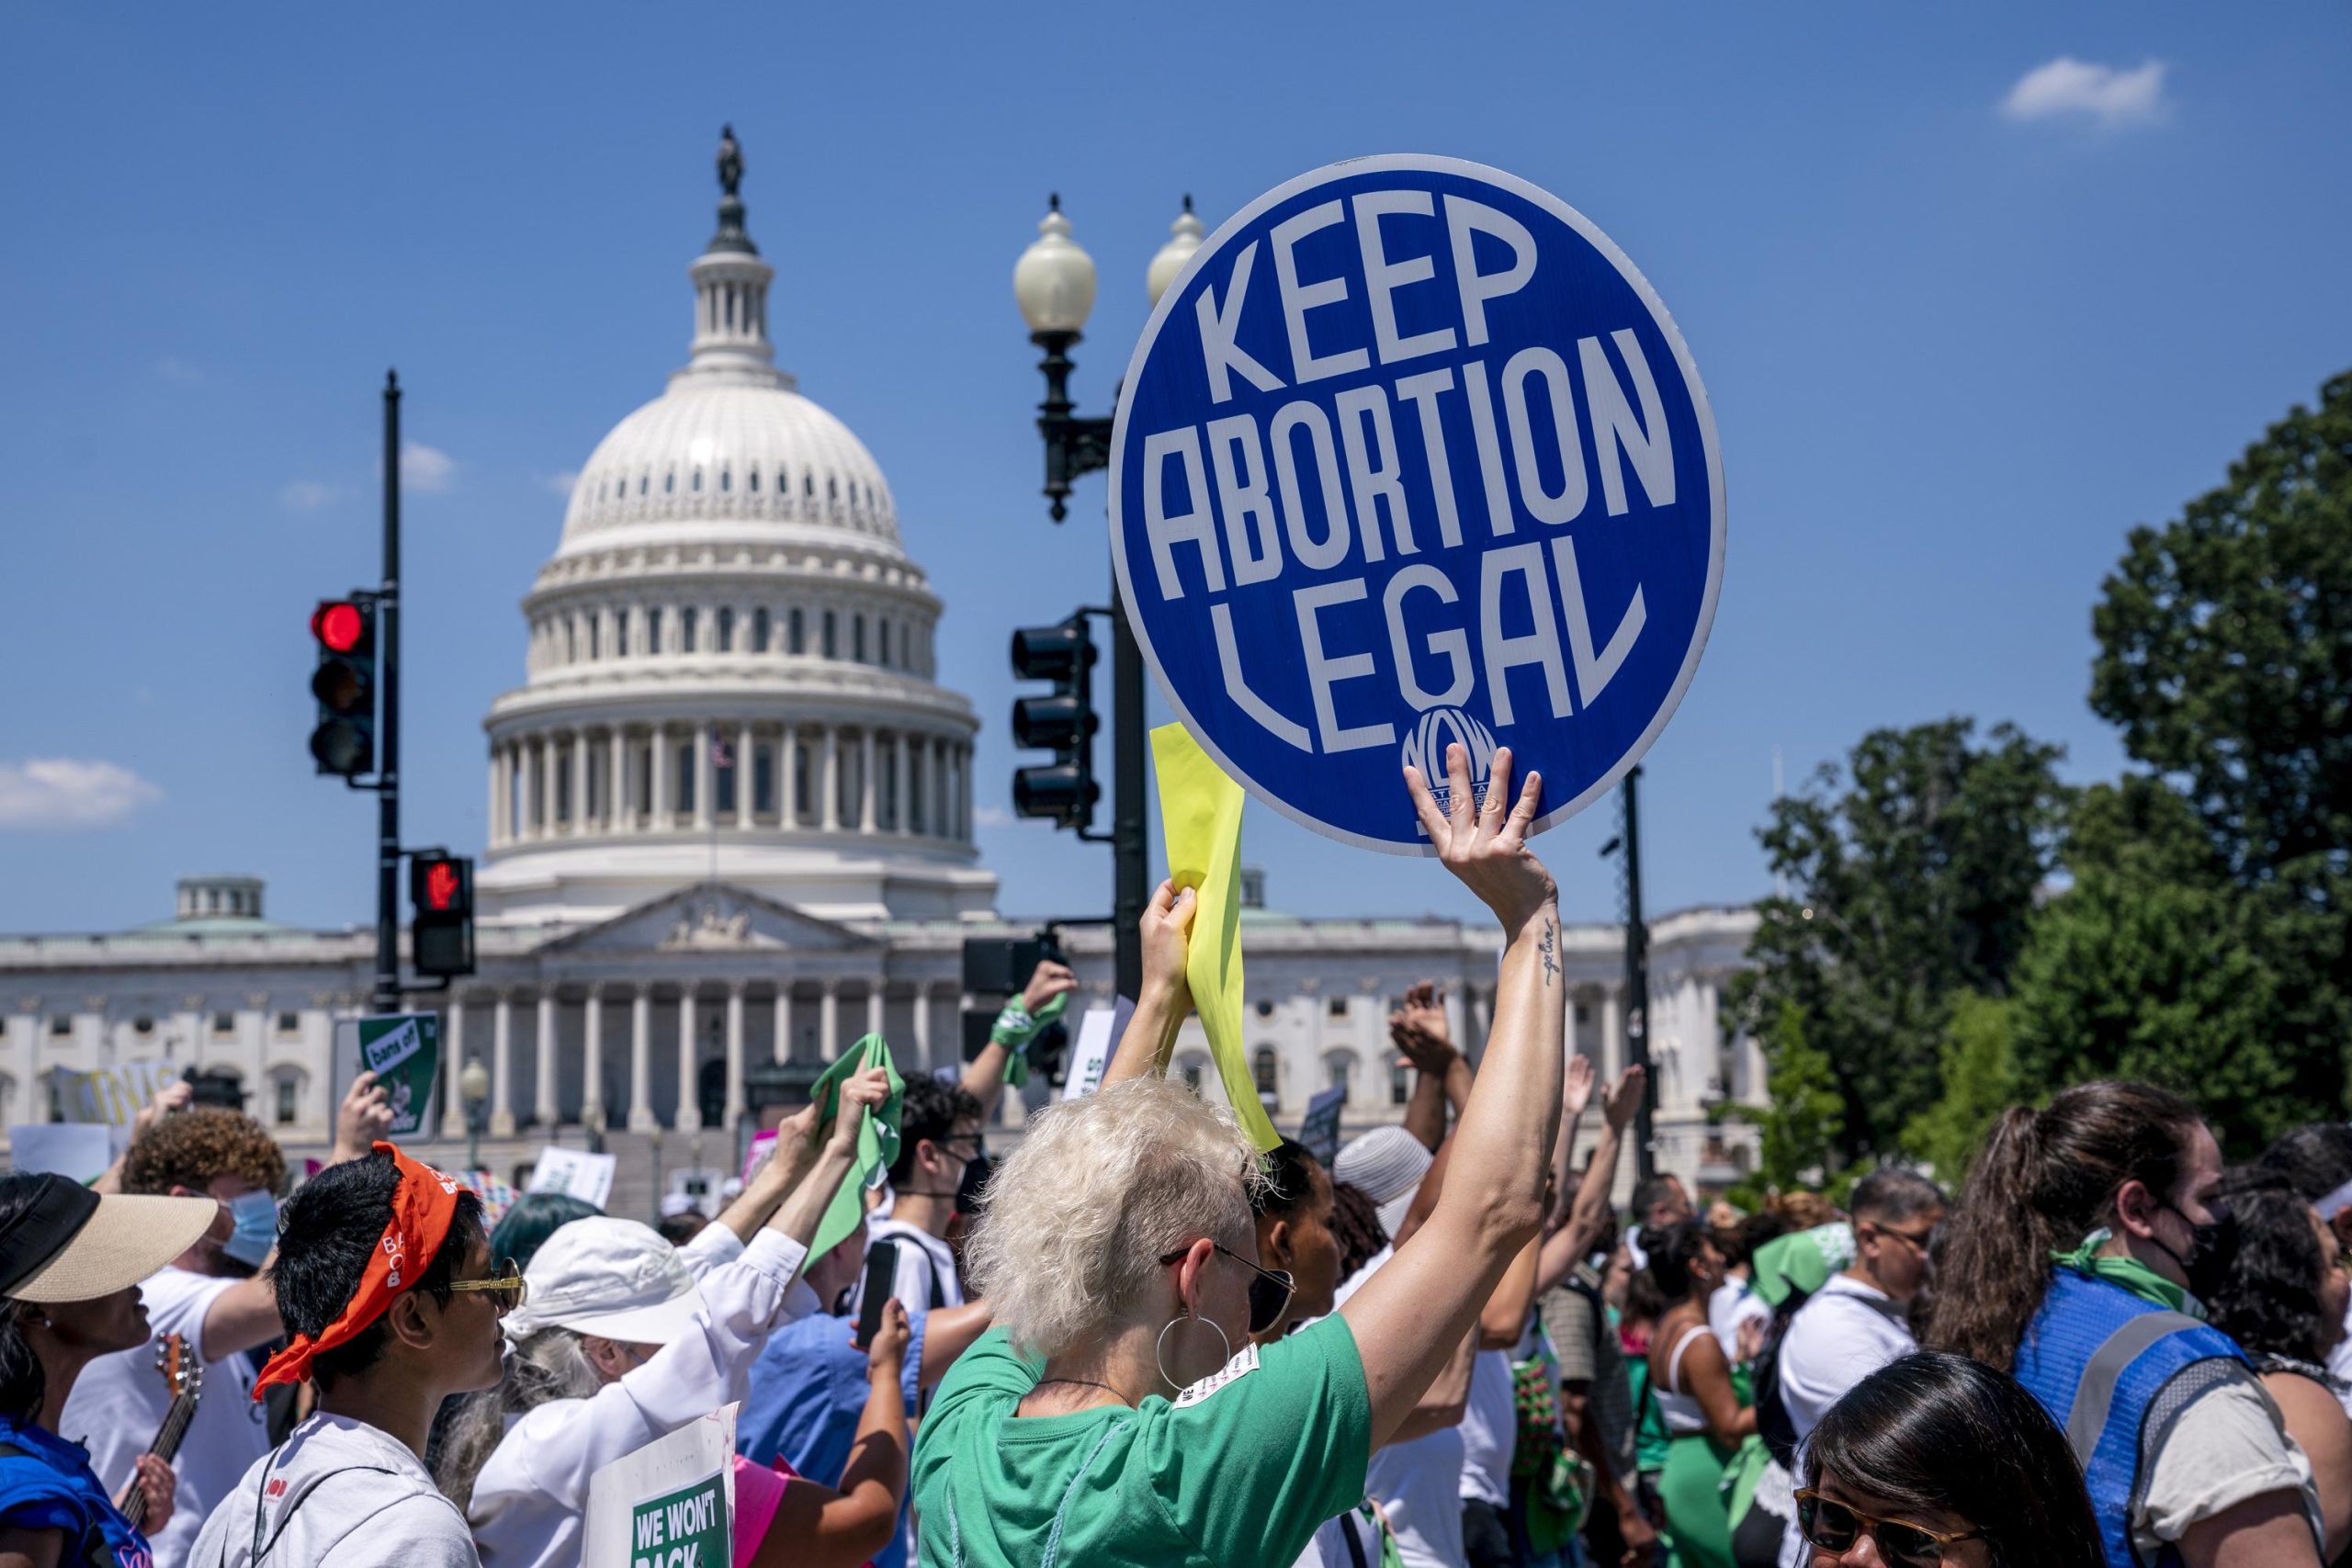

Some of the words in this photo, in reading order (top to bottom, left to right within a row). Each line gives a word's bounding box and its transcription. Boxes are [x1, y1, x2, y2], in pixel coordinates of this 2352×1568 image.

[1194, 189, 1538, 404] KEEP
[1143, 327, 1677, 601] ABORTION
[1209, 536, 1647, 755] LEGAL
[1401, 708, 1498, 789] NOW
[636, 1542, 698, 1568] CK
[637, 1508, 663, 1551] WE
[667, 1489, 715, 1541] WON'T
